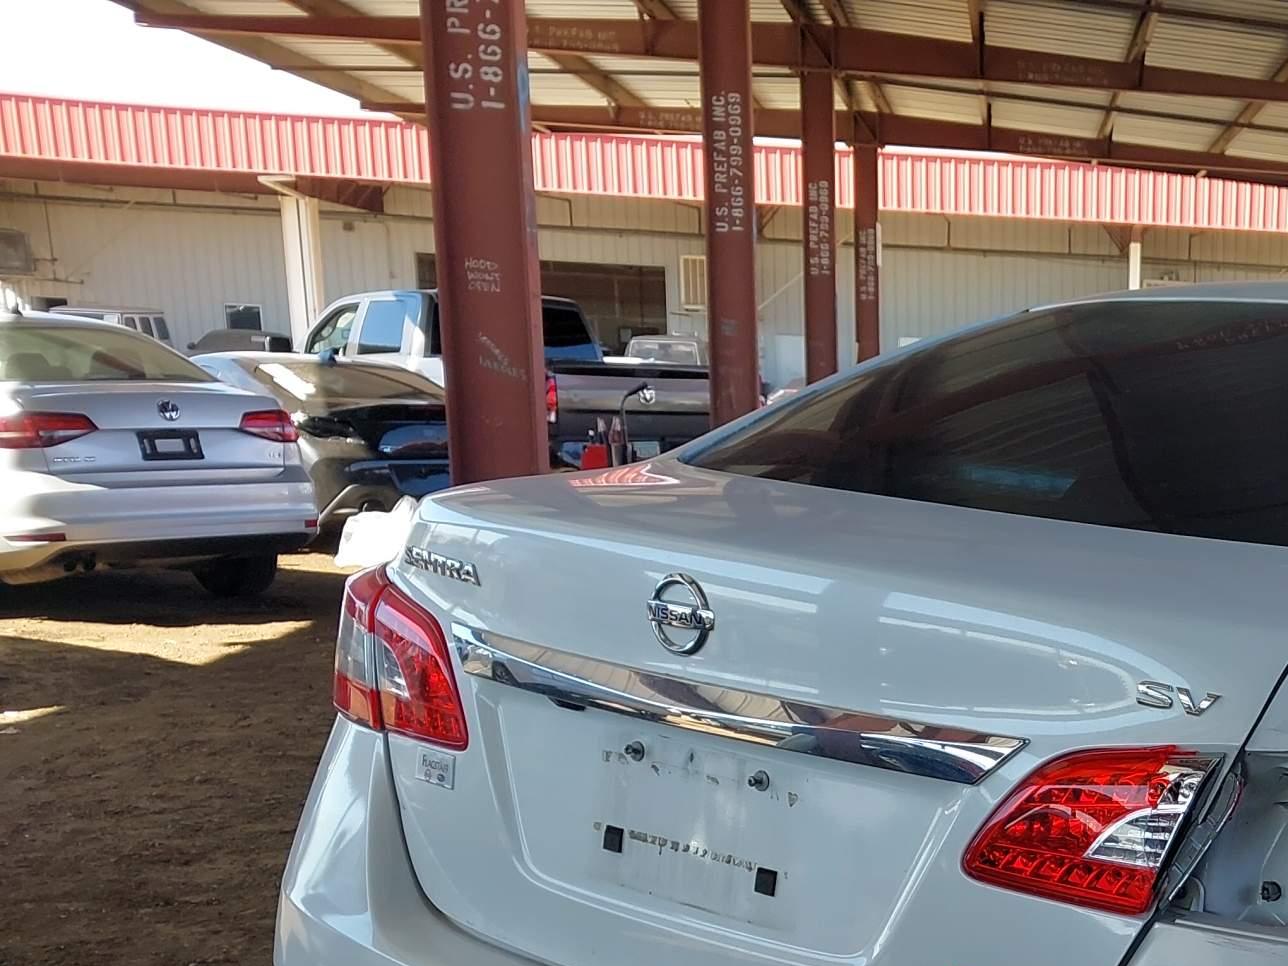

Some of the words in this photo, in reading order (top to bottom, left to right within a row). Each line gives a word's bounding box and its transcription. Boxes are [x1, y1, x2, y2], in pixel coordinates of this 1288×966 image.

[477, 0, 506, 109] 1-866-
[449, 54, 475, 110] U.S.
[713, 130, 728, 193] PREFAB
[727, 92, 744, 231] 1-866-799-0969
[715, 202, 729, 232] U.S.
[464, 258, 499, 271] HOOD
[404, 545, 481, 587] SENTRA
[648, 603, 704, 626] NISSAN
[1136, 680, 1223, 717] SV
